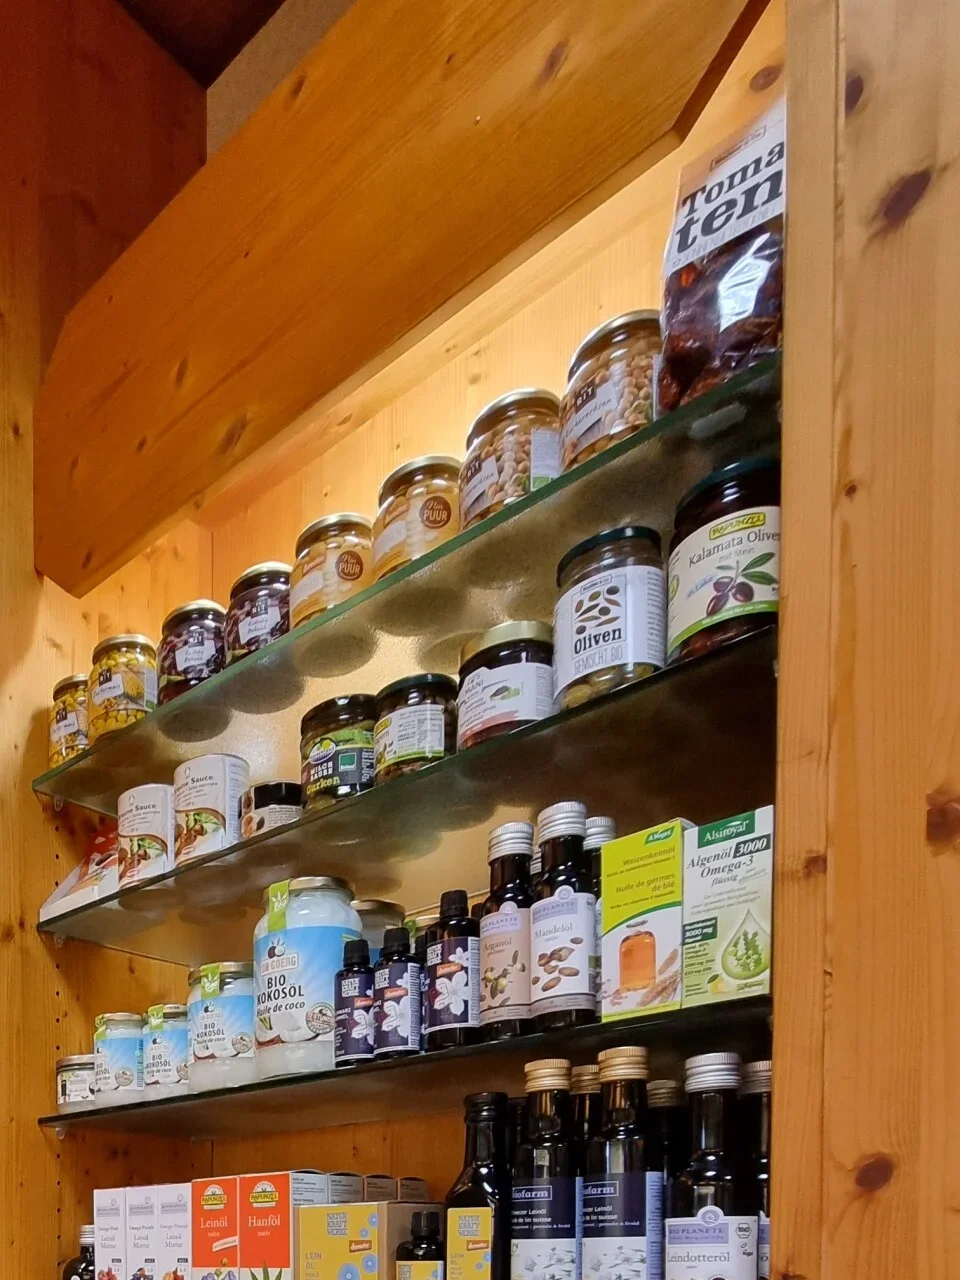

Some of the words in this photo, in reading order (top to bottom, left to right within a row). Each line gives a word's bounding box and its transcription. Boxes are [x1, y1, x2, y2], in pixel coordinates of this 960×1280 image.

[681, 140, 785, 219] Toma
[675, 169, 784, 255] ten
[424, 509, 448, 523] PUUR
[689, 537, 743, 568] Kalamata
[339, 561, 360, 575] PUUR
[574, 627, 622, 654] Oliven
[311, 761, 333, 774] MILCH
[191, 775, 214, 784] Sauce
[306, 776, 340, 794] Gurken
[135, 803, 156, 811] Sauce
[704, 820, 749, 843] Alsiroyal
[623, 846, 676, 867] Weizenkeimöl
[687, 848, 731, 870] Algenöl
[736, 837, 768, 857] 3000
[700, 855, 754, 879] Omega-3
[616, 882, 635, 893] Huile
[646, 873, 676, 888] germes
[662, 880, 675, 892] blé
[712, 873, 738, 887] flüssig
[534, 923, 573, 940] Mandelöl
[484, 937, 512, 951] Arganöl
[267, 975, 286, 990] BIO
[257, 984, 304, 1005] KOKOSÖL
[273, 1003, 283, 1013] de
[285, 1000, 305, 1011] coco
[196, 1027, 225, 1039] KOKOSÖL
[204, 1022, 216, 1031] BIO
[200, 1217, 228, 1228] Leinöl
[248, 1214, 280, 1228] Hanföl
[682, 1227, 724, 1235] PLANETE
[306, 1252, 322, 1260] LEIN
[668, 1251, 730, 1263] Leindotteröl
